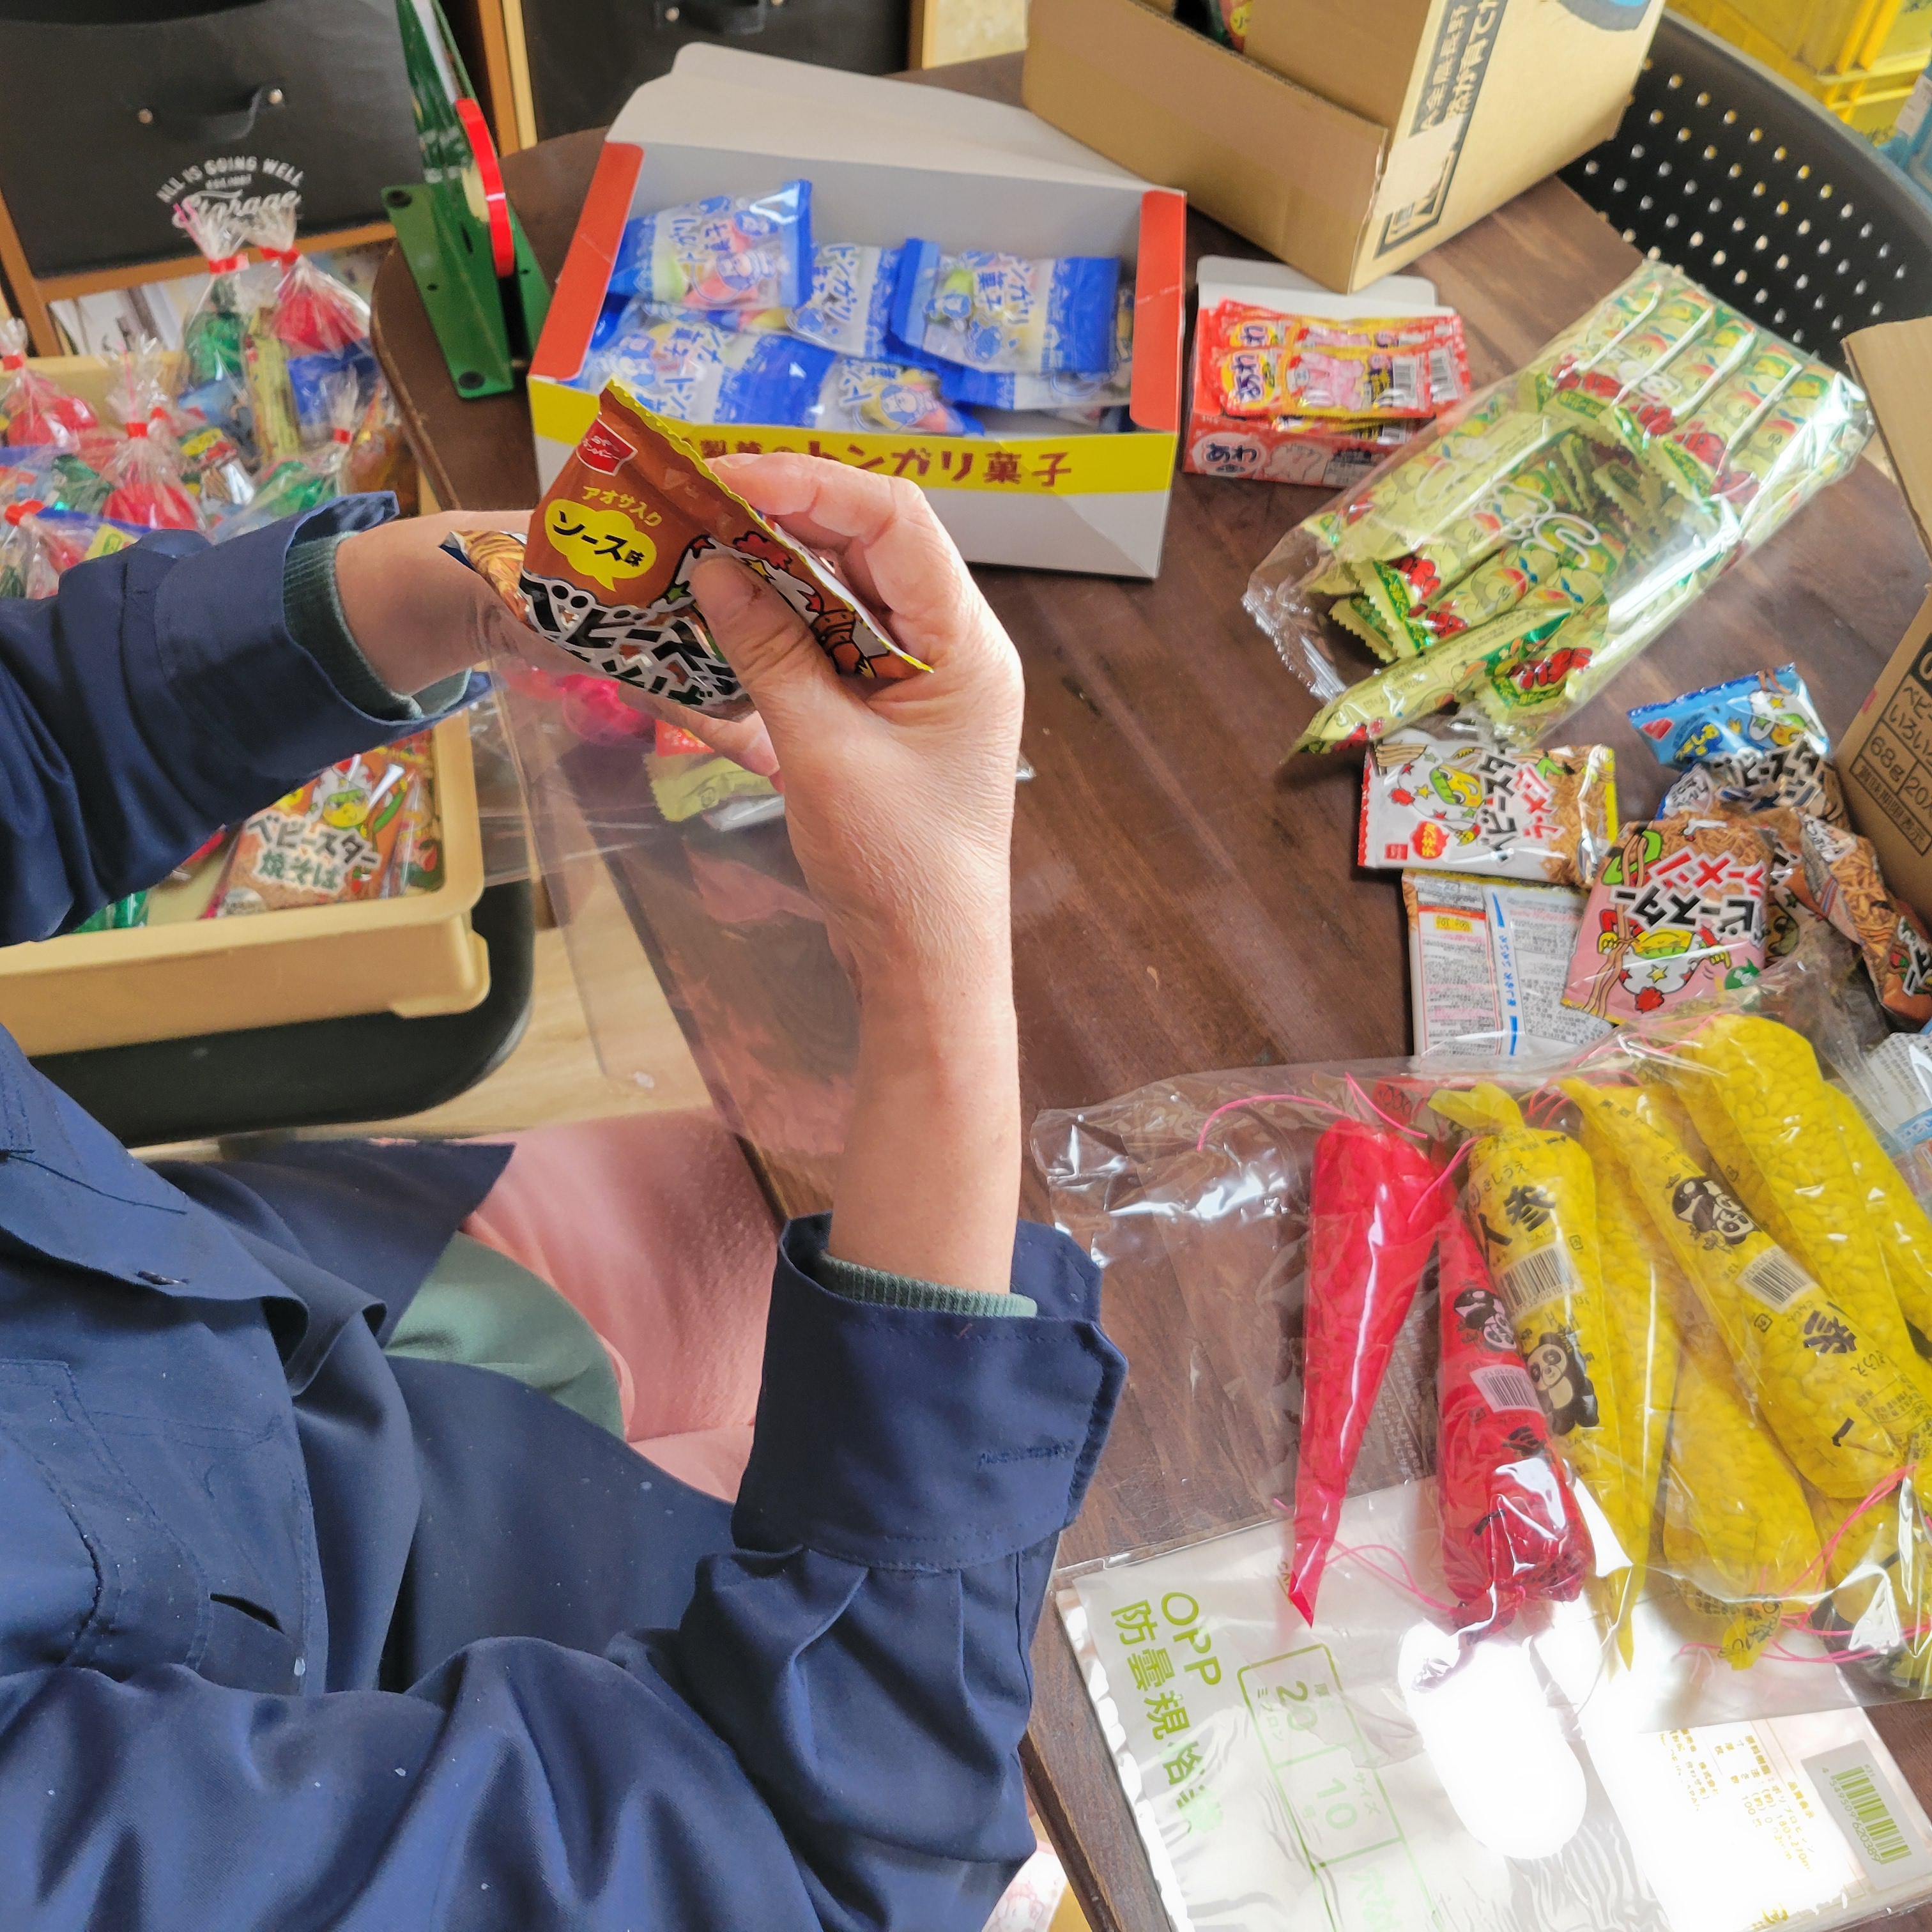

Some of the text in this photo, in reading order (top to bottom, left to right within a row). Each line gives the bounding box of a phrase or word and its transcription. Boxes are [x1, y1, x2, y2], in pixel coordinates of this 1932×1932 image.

[204, 157, 257, 175] GOING
[263, 158, 303, 188] WELL
[1008, 263, 1032, 325] ンガリ
[582, 486, 663, 527] アオサ入り
[553, 510, 644, 567] ソース味
[1869, 736, 1905, 784] 68g
[247, 817, 377, 866] ベビースター
[259, 850, 339, 891] 焼そば
[1653, 851, 1763, 891] ラーメン
[1613, 884, 1765, 947] ビースター
[1482, 1161, 1529, 1192] きしうえ
[1160, 1591, 1222, 1685] OPP
[1276, 1680, 1318, 1731] 20
[1316, 1777, 1358, 1830] 10
